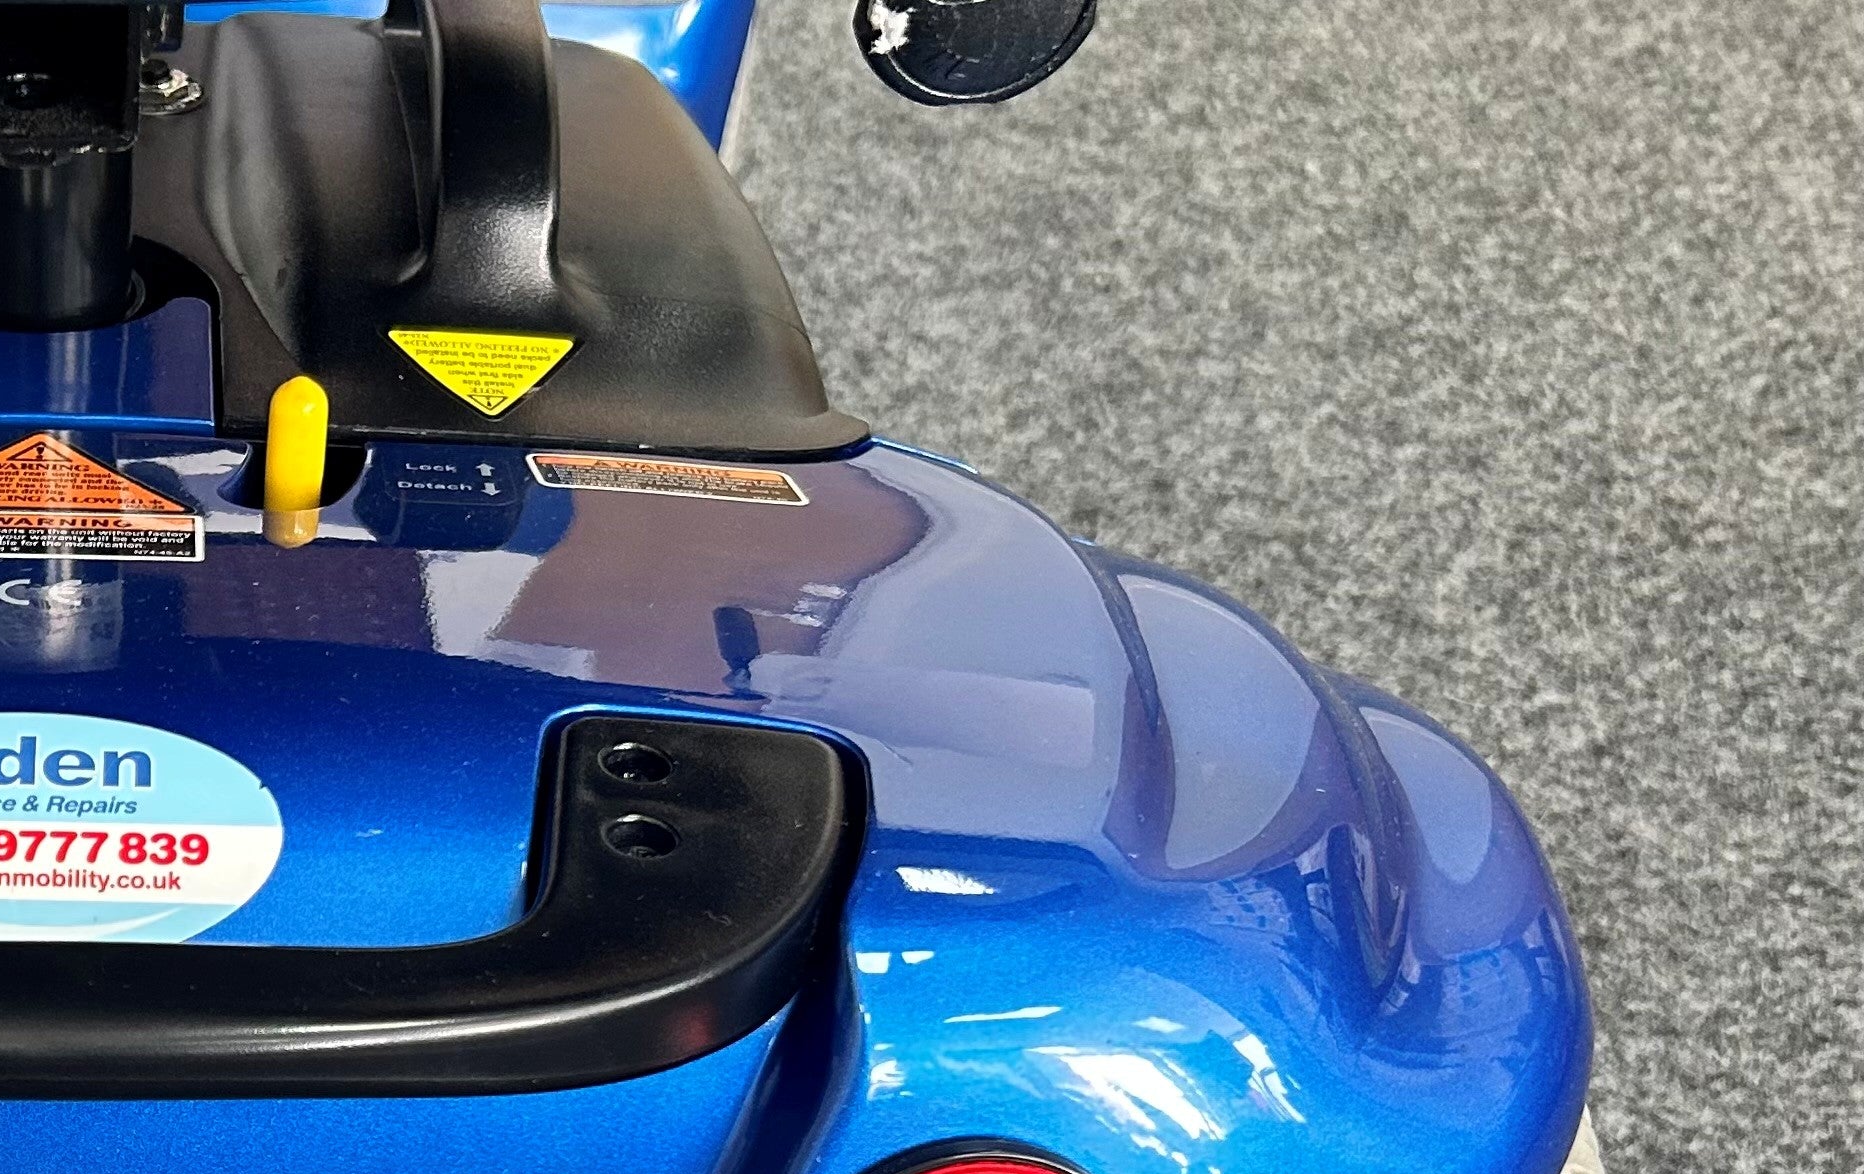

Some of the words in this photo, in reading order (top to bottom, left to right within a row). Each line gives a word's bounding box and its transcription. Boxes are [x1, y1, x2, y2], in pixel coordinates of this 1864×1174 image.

[397, 480, 473, 491] Detach
[148, 531, 191, 539] factory
[22, 795, 38, 813] &
[46, 795, 137, 817] Repairs
[118, 832, 210, 866] 839
